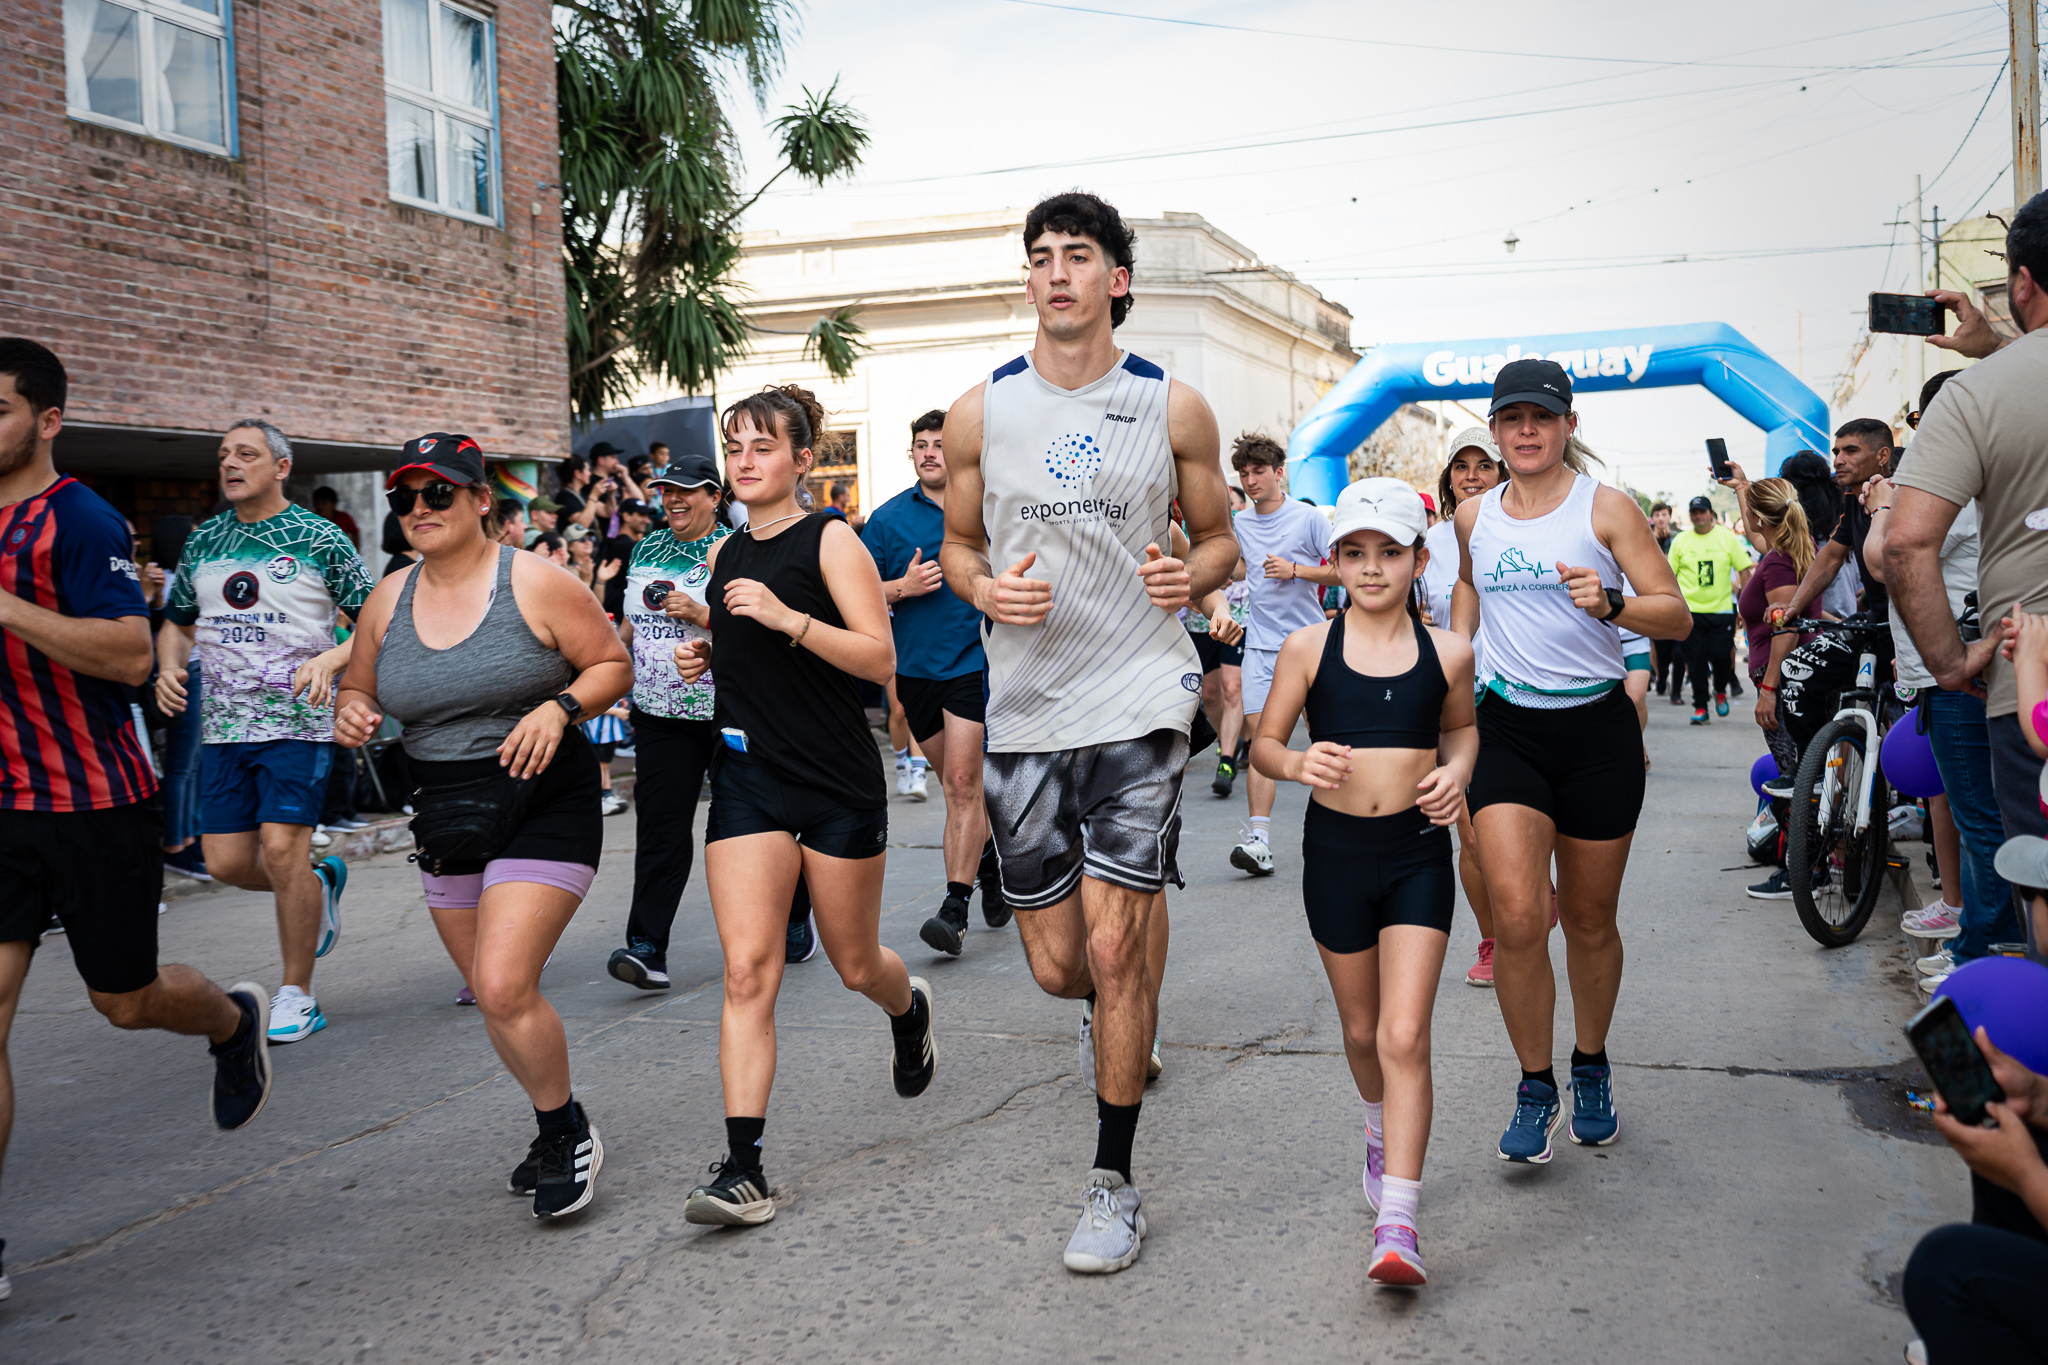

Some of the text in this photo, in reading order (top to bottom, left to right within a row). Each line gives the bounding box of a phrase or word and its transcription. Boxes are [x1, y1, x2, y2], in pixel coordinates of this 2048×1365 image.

[1422, 344, 1654, 387] Guaguay
[1484, 583, 1519, 593] EMPEZÁ
[1528, 583, 1569, 591] CORRER
[221, 626, 265, 644] 2026
[642, 625, 685, 641] 2026
